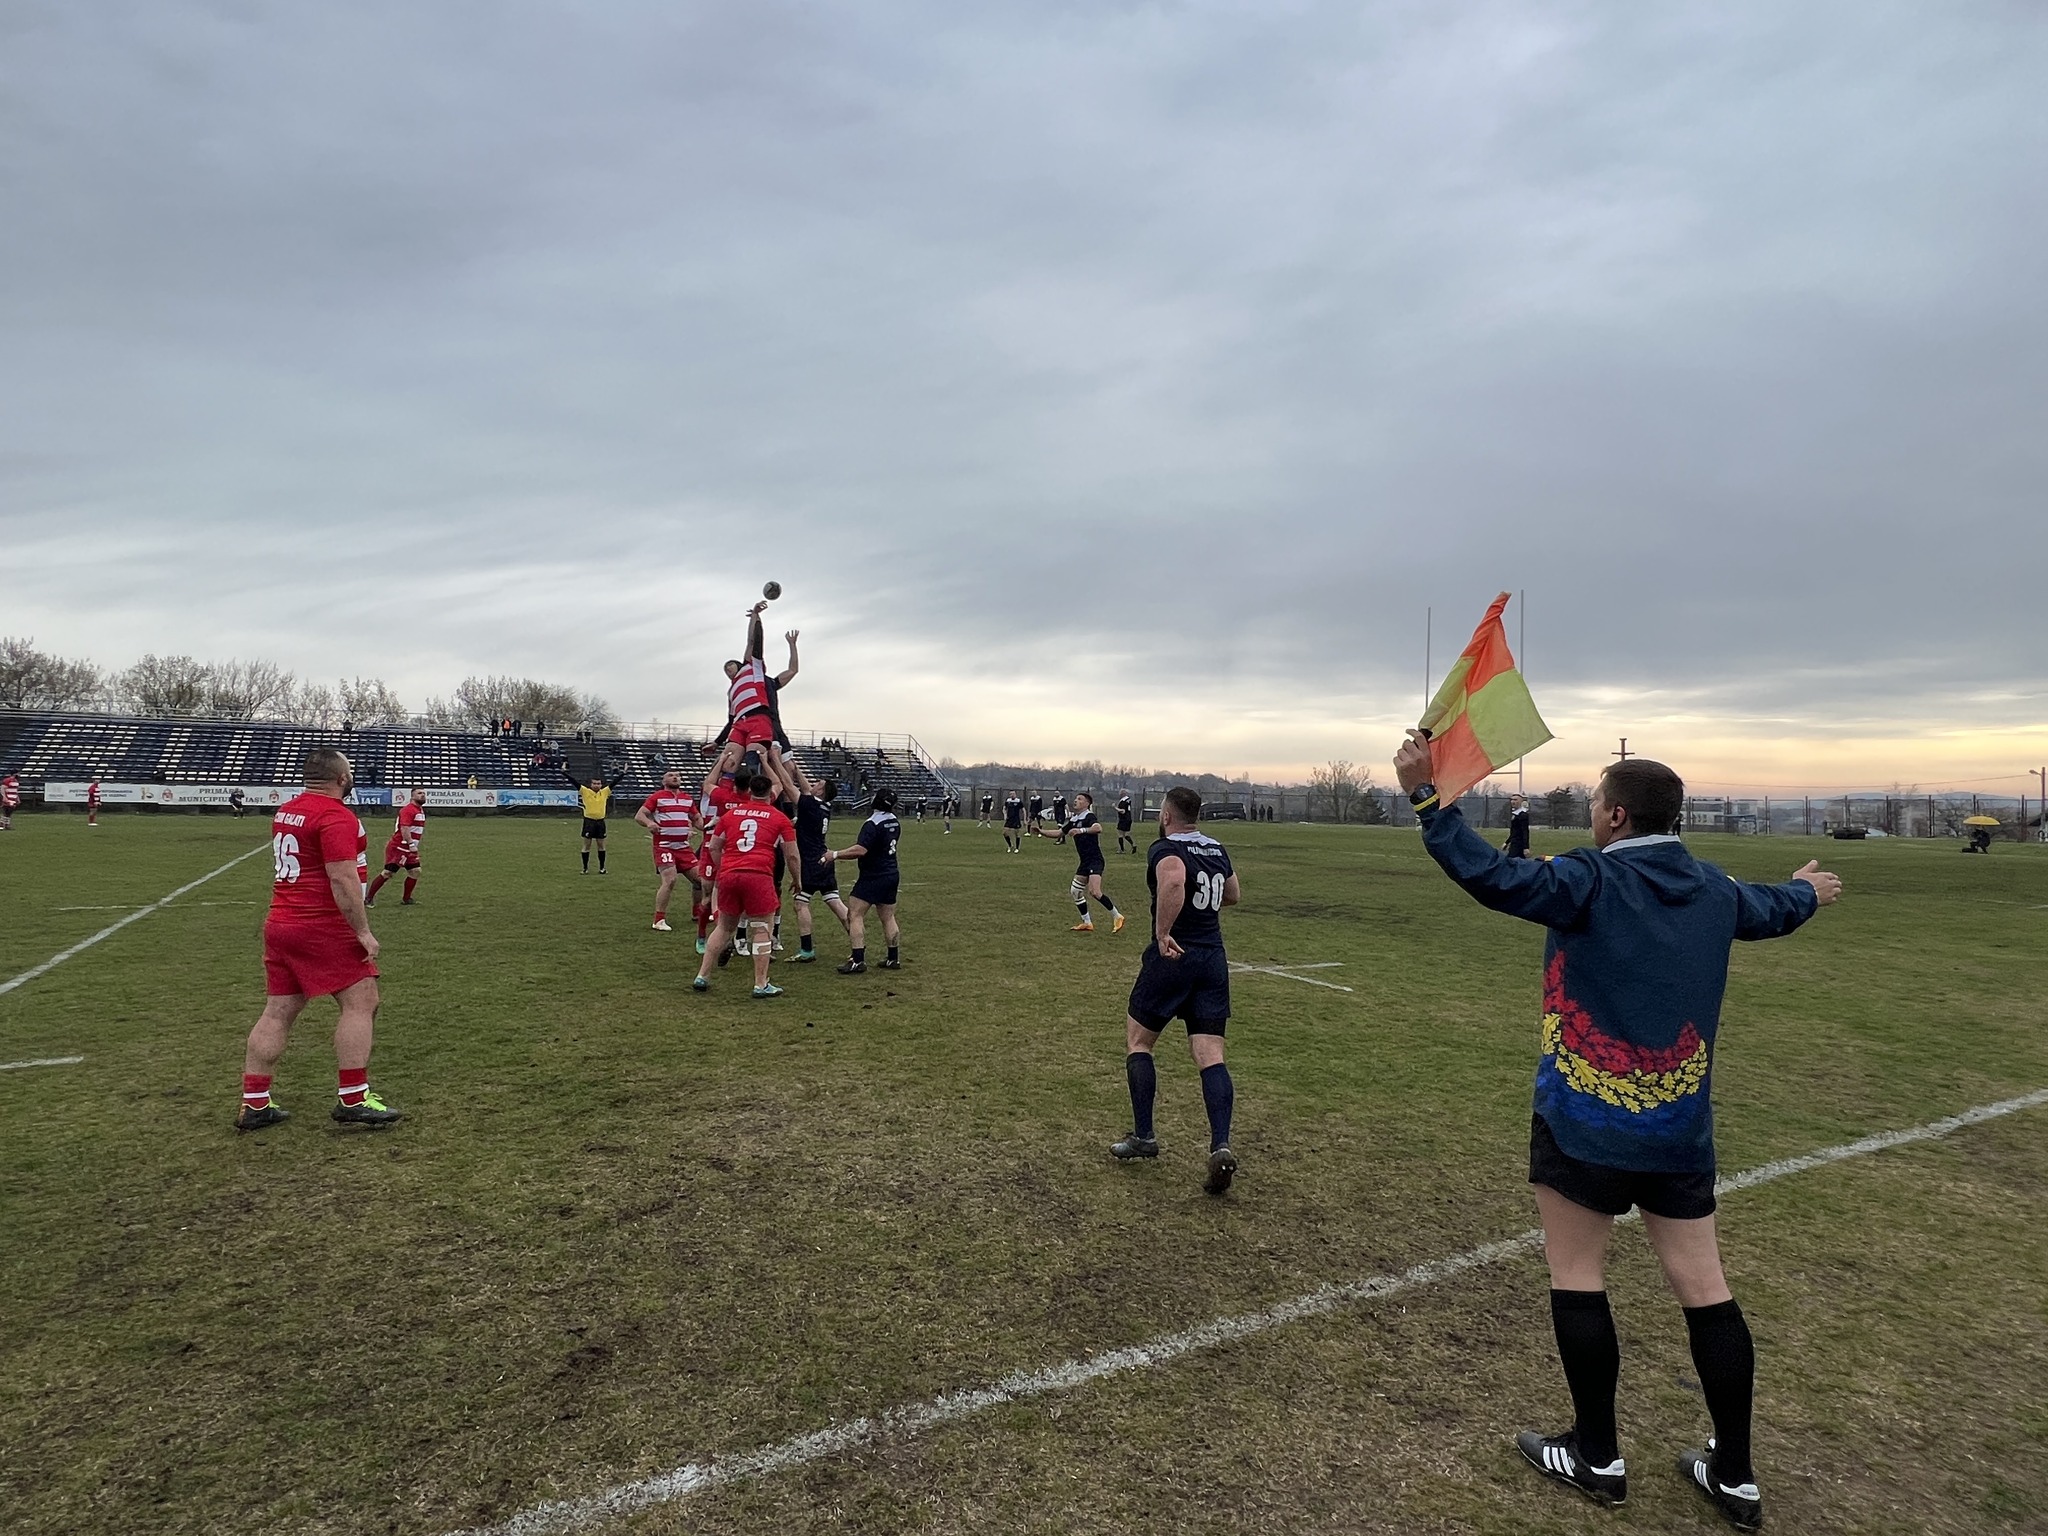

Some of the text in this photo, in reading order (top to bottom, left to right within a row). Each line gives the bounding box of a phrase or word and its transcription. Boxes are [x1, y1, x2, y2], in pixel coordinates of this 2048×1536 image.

[736, 818, 758, 853] 3
[272, 831, 301, 884] 16
[661, 852, 673, 863] 32
[705, 865, 713, 877] 8
[1192, 870, 1226, 912] 30
